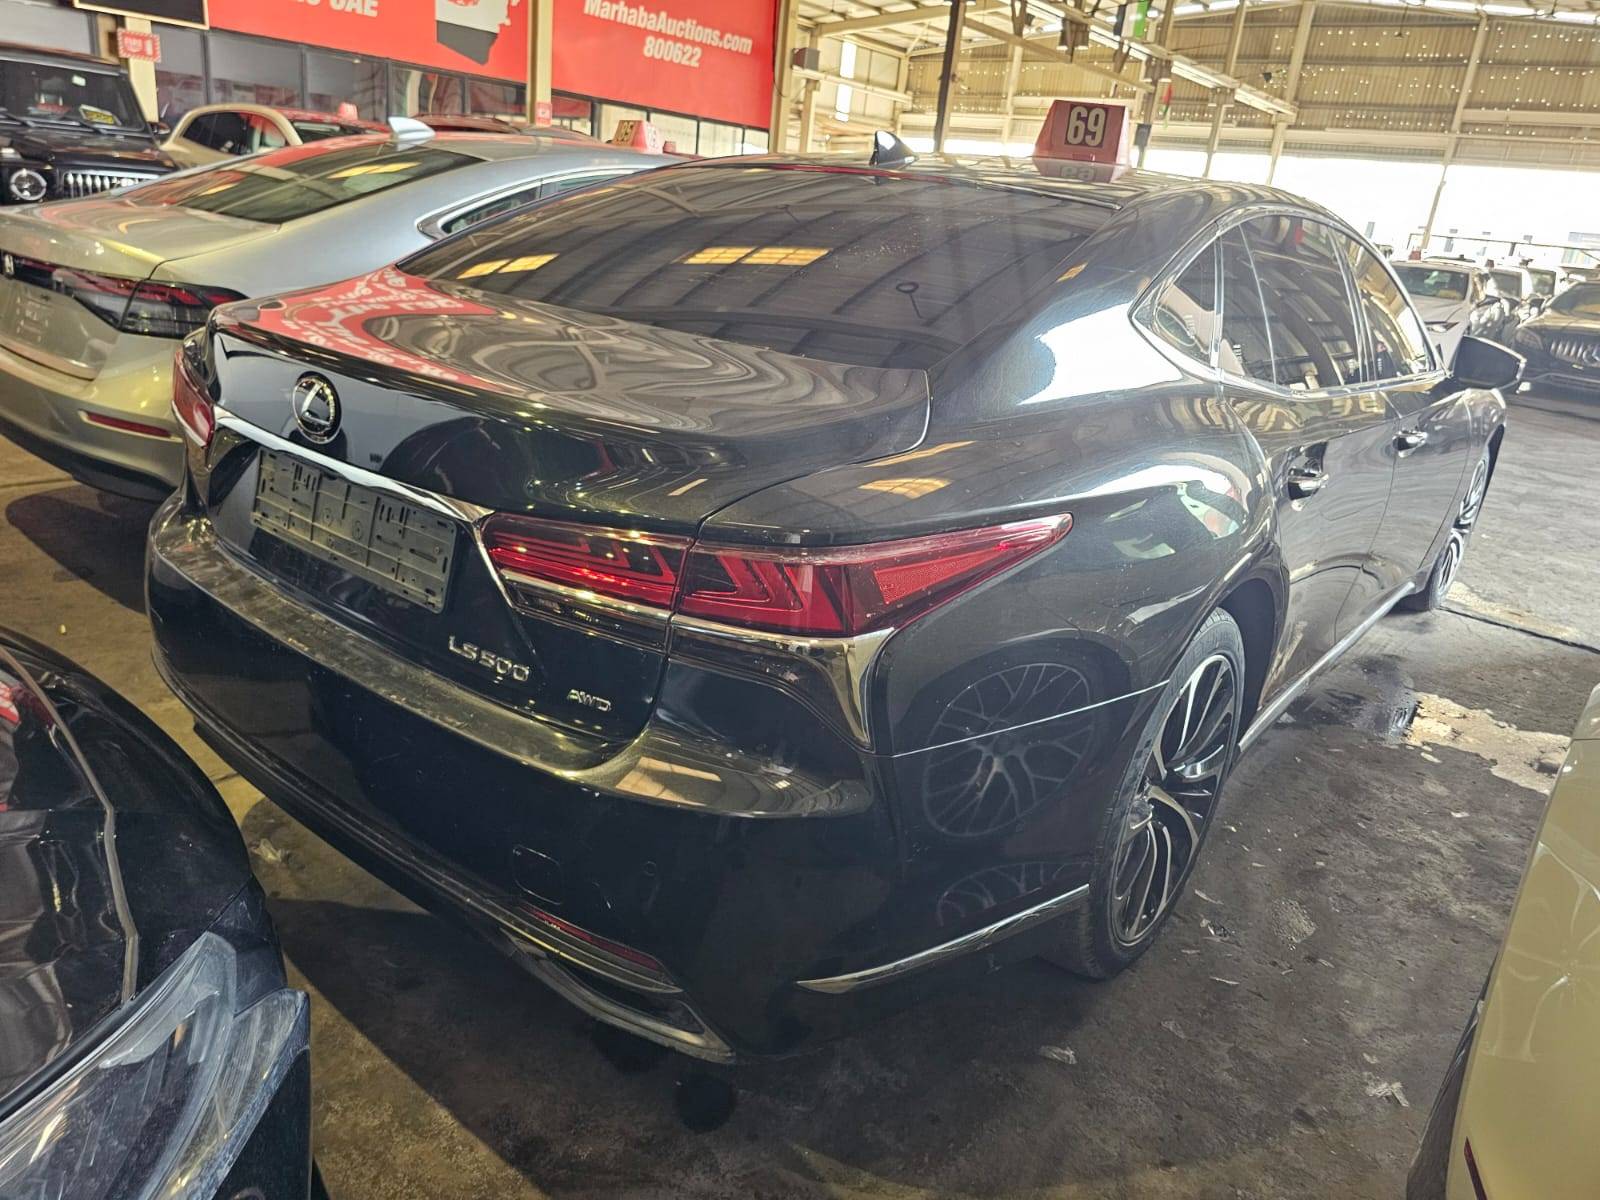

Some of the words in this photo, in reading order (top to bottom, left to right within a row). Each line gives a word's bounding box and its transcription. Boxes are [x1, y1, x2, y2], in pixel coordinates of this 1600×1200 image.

[583, 0, 753, 55] MarhabaAuctions.com
[643, 36, 702, 68] 800622
[1067, 105, 1106, 147] 69
[566, 688, 612, 712] AWD
